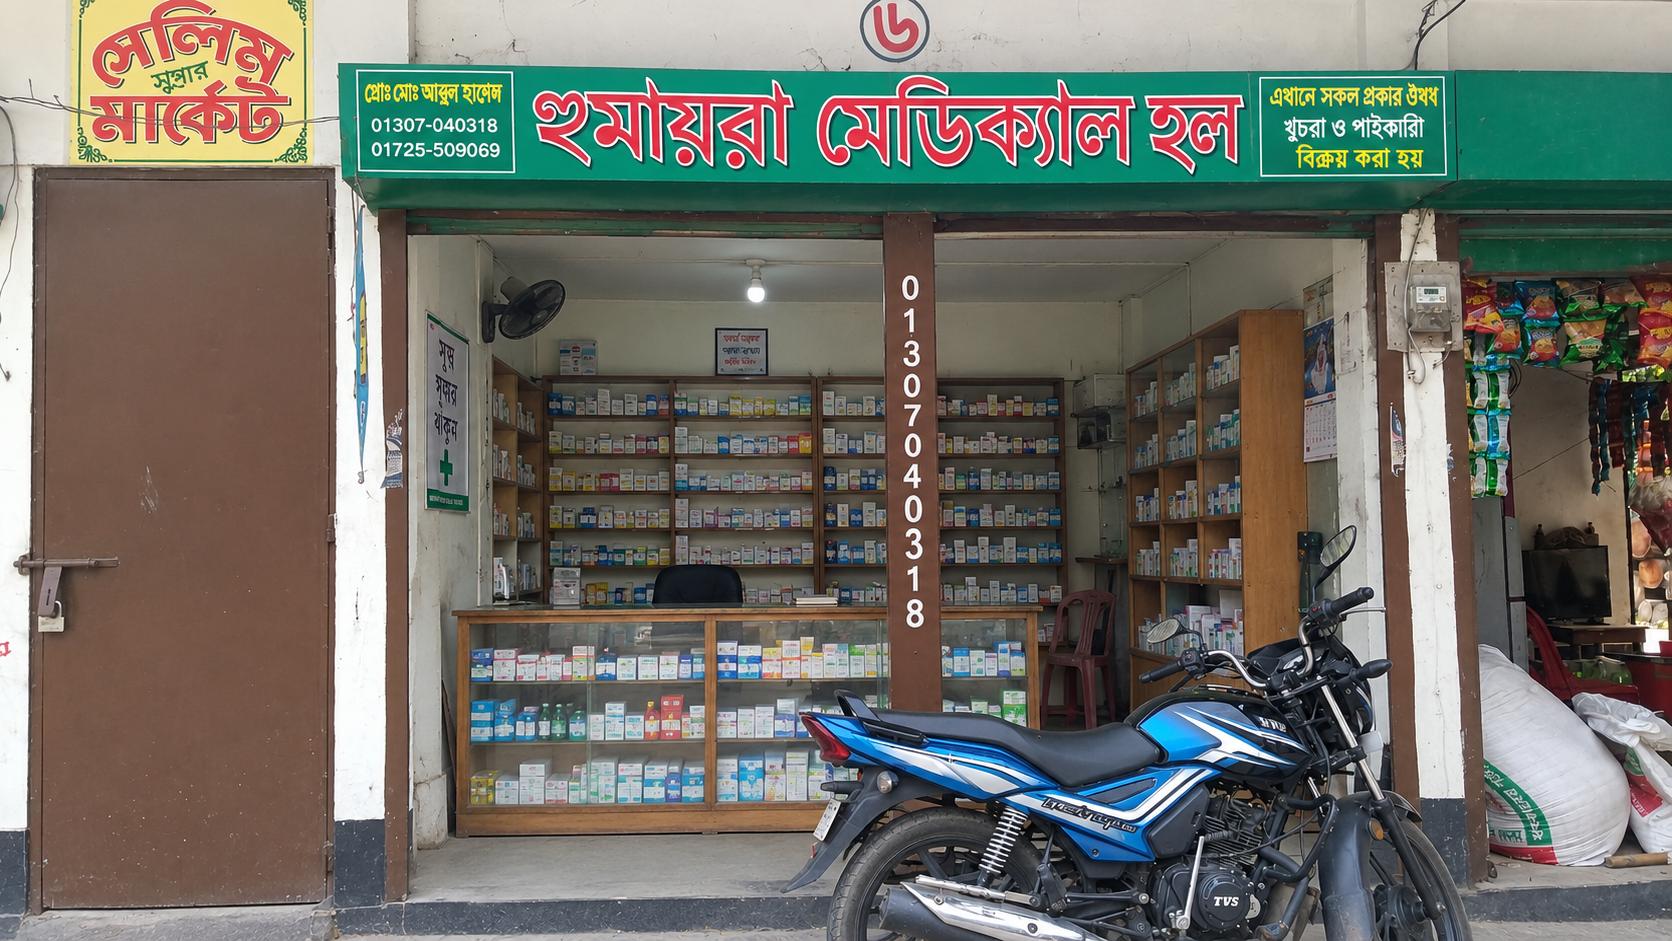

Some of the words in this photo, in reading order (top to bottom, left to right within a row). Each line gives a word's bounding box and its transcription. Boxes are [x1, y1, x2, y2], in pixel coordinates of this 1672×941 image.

[873, 1, 920, 54] ৬
[393, 82, 419, 102] মোঃ
[1320, 86, 1360, 107] সকল
[1363, 86, 1403, 107] প্রকার
[90, 76, 292, 145] মার্কেট
[371, 117, 498, 133] 01307-040318
[816, 75, 1134, 168] মেডিক্যাল
[1145, 95, 1245, 175] হল
[1284, 117, 1326, 142] খুচরা
[1332, 119, 1346, 138] ও
[371, 142, 500, 158] 01725-509069
[1354, 148, 1390, 168] করা
[1396, 149, 1424, 169] হয়
[901, 274, 925, 630] 01307040318
[1213, 896, 1239, 907] TVS
